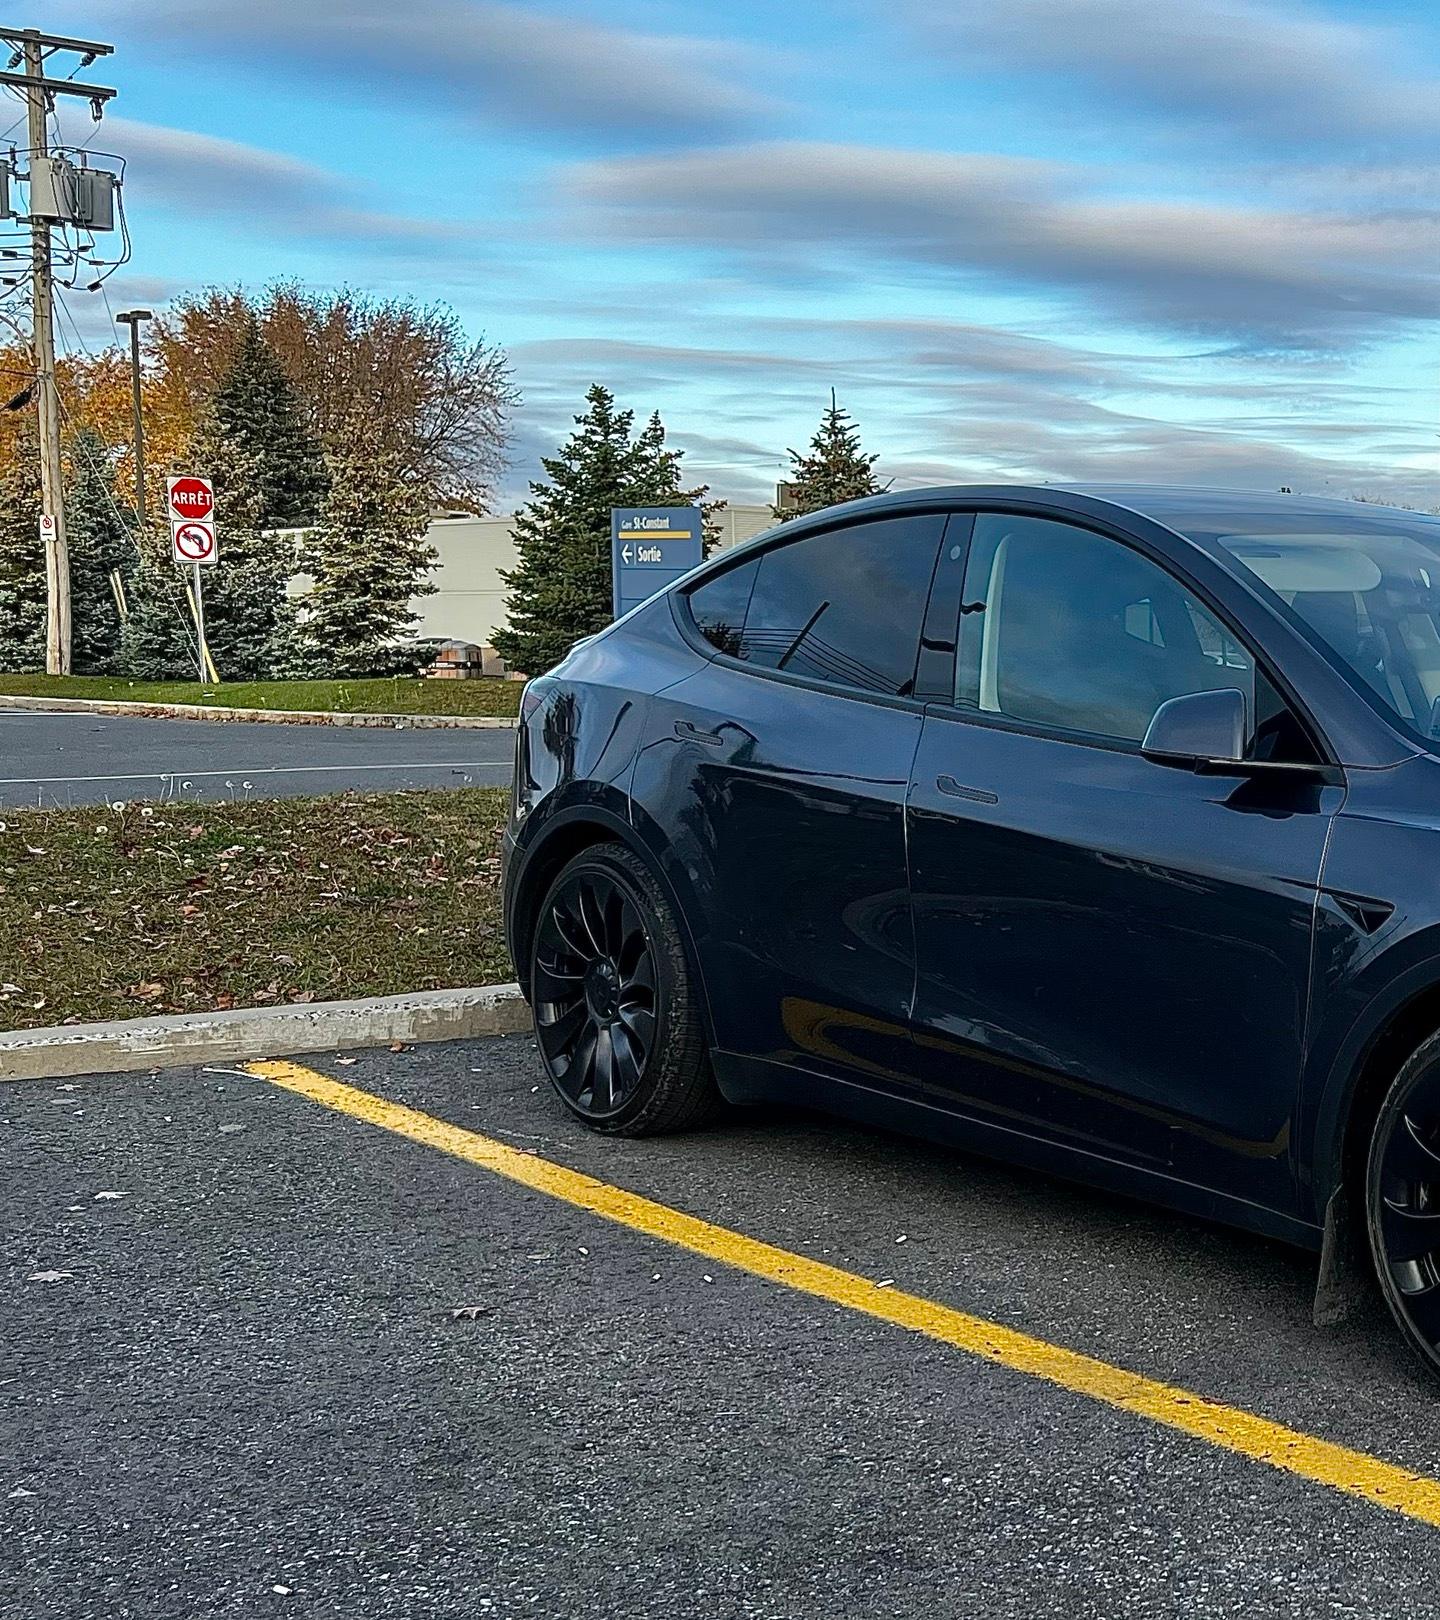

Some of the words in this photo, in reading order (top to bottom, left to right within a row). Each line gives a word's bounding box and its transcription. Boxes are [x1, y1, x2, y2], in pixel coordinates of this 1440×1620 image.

[173, 490, 212, 506] ARRÊT
[633, 516, 670, 529] St-Constant
[638, 545, 662, 562] Sortie
